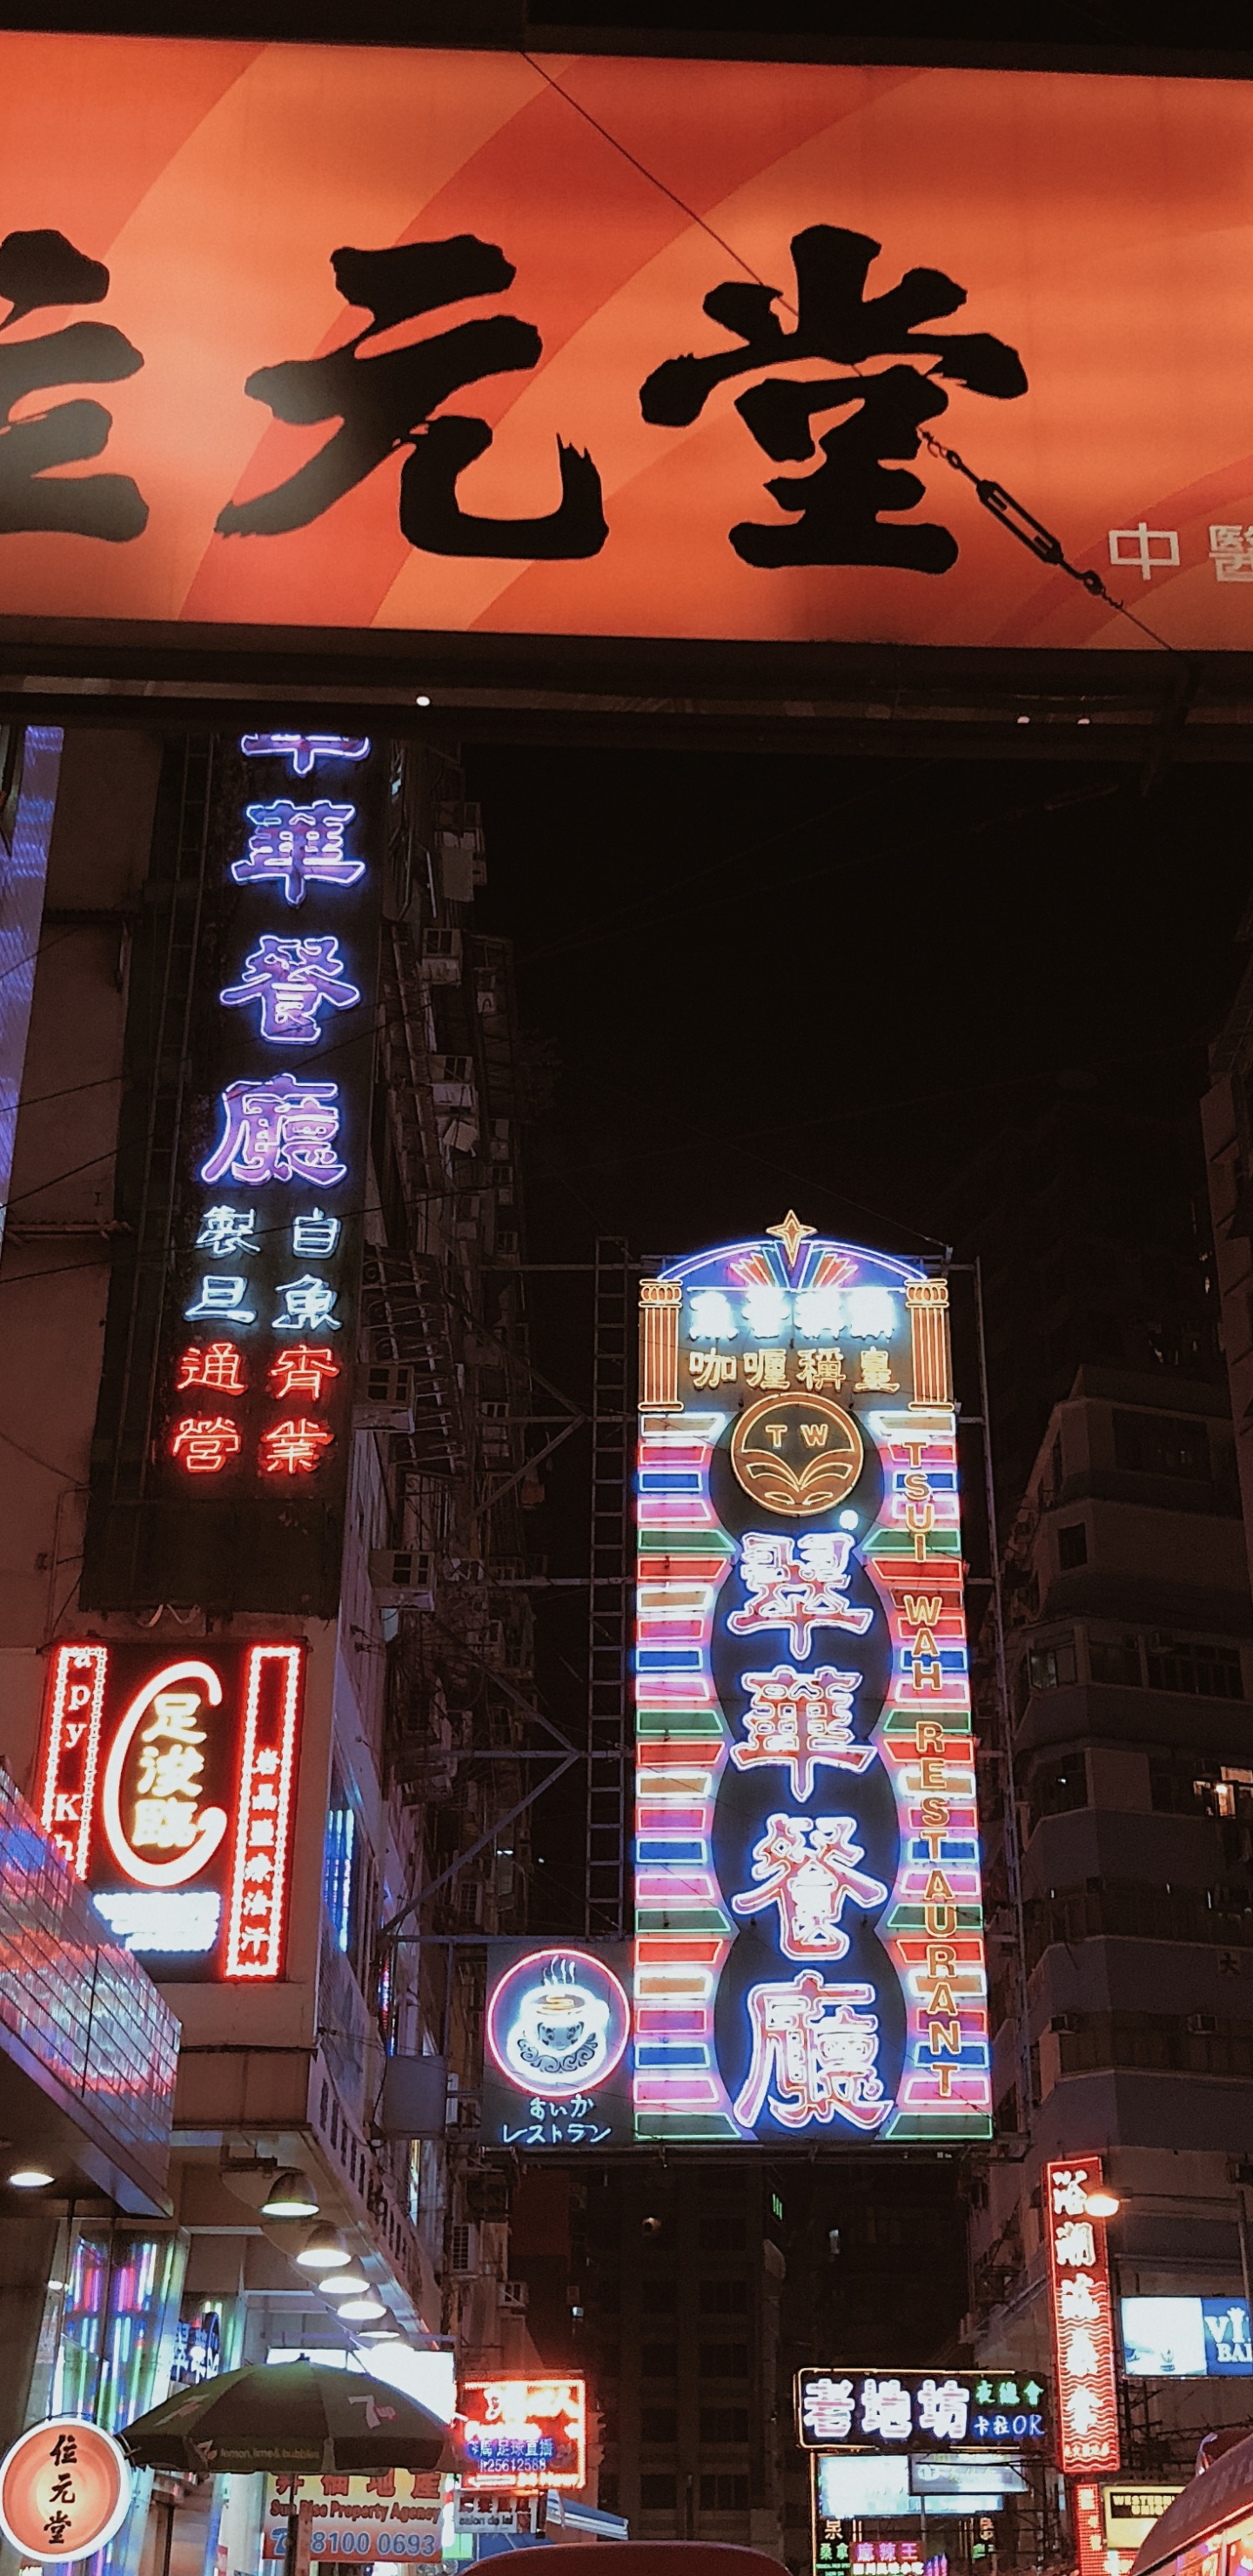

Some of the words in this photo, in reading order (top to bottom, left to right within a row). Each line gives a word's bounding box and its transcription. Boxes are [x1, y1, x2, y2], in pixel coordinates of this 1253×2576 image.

[903, 1440, 935, 1563] TSUI
[904, 1594, 942, 1691] WAH
[727, 1533, 895, 2130] 翠華餐廳
[916, 1721, 962, 2097] RESTAURANT
[502, 2123, 613, 2144] レストラン
[1204, 2306, 1251, 2344] VI
[44, 2434, 78, 2545] 位元堂
[330, 2500, 389, 2522] Property
[390, 2502, 441, 2524] Agency
[1131, 2505, 1167, 2516] UNIO
[311, 2531, 371, 2554] 8100
[376, 2532, 436, 2557] 0693
